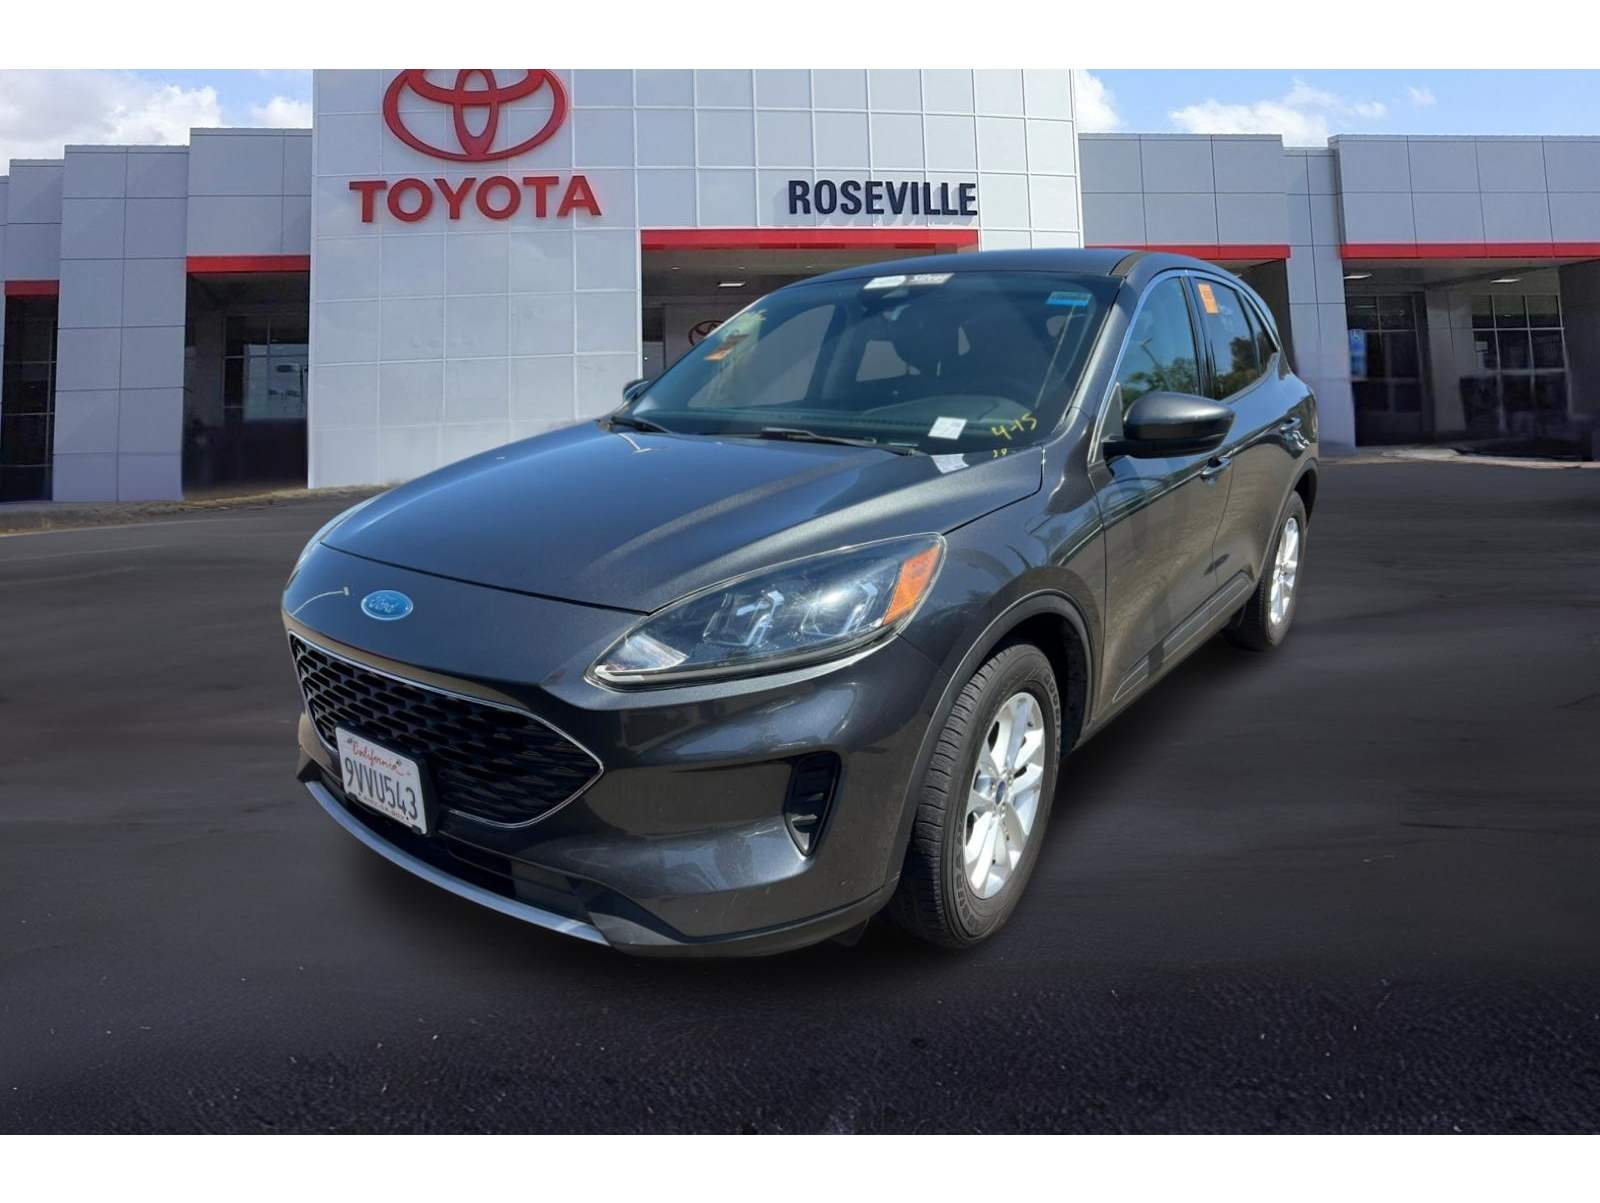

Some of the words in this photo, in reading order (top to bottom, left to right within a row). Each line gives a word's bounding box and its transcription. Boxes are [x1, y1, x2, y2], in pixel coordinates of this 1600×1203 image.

[349, 175, 602, 223] TOYOTA
[788, 180, 978, 216] ROSEVILLE
[344, 756, 419, 821] 9VVU543
